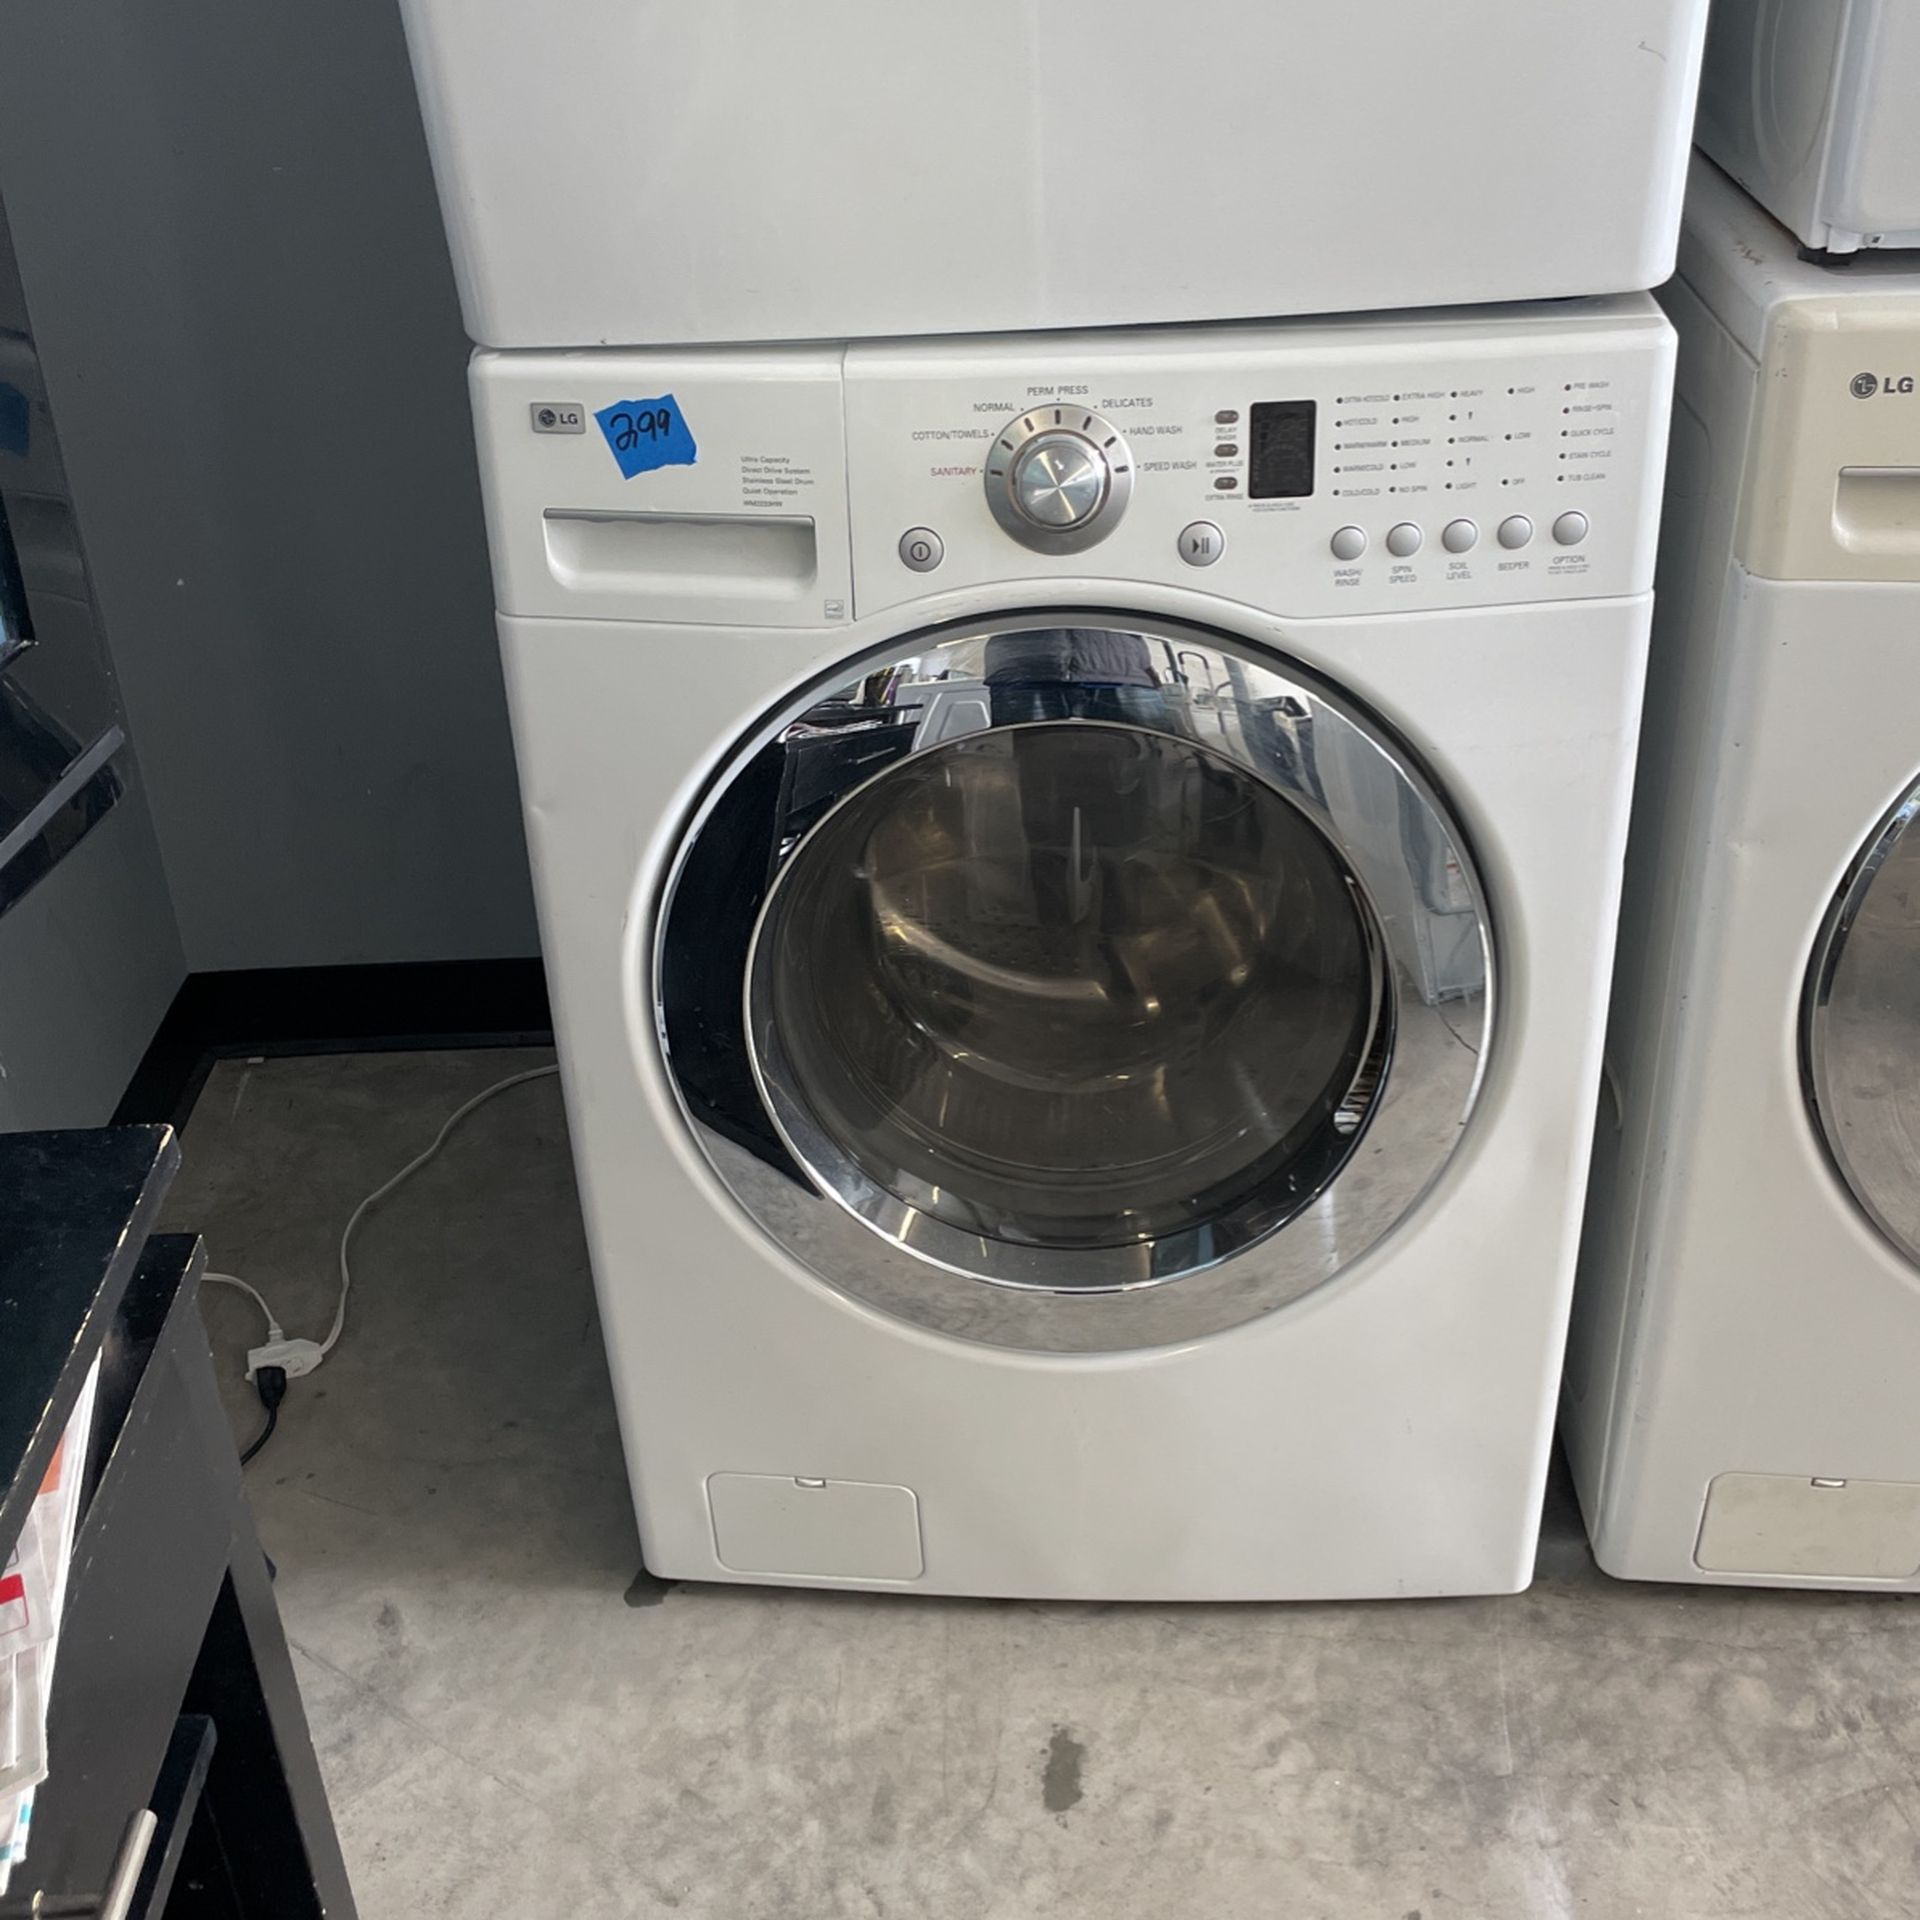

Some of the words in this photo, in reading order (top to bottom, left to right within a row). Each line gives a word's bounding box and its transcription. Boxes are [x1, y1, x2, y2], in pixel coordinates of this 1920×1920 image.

[1883, 377, 1914, 393] LG
[1026, 386, 1054, 396] PERM
[1057, 385, 1089, 395] PRESS
[973, 402, 1015, 413] NORMAL
[1101, 398, 1154, 408] DELICATES
[560, 412, 578, 425] LG
[609, 407, 672, 452] 299
[912, 428, 990, 440] COTTON/TOWELS
[1129, 426, 1154, 436] HAND
[1156, 425, 1183, 434] WASH
[760, 456, 790, 464] Capacity
[764, 466, 782, 474] Drive
[1143, 461, 1170, 471] SPEED
[1172, 460, 1198, 470] WASH
[930, 467, 976, 476] SANITARY
[1552, 555, 1586, 565] OPTION
[1392, 566, 1412, 574] SPIN
[1448, 562, 1468, 571] SOIL
[1498, 561, 1530, 571] BEEPER
[1389, 574, 1417, 584] SPEED
[1446, 570, 1472, 580] LEVEL
[1334, 577, 1361, 586] RINSE
